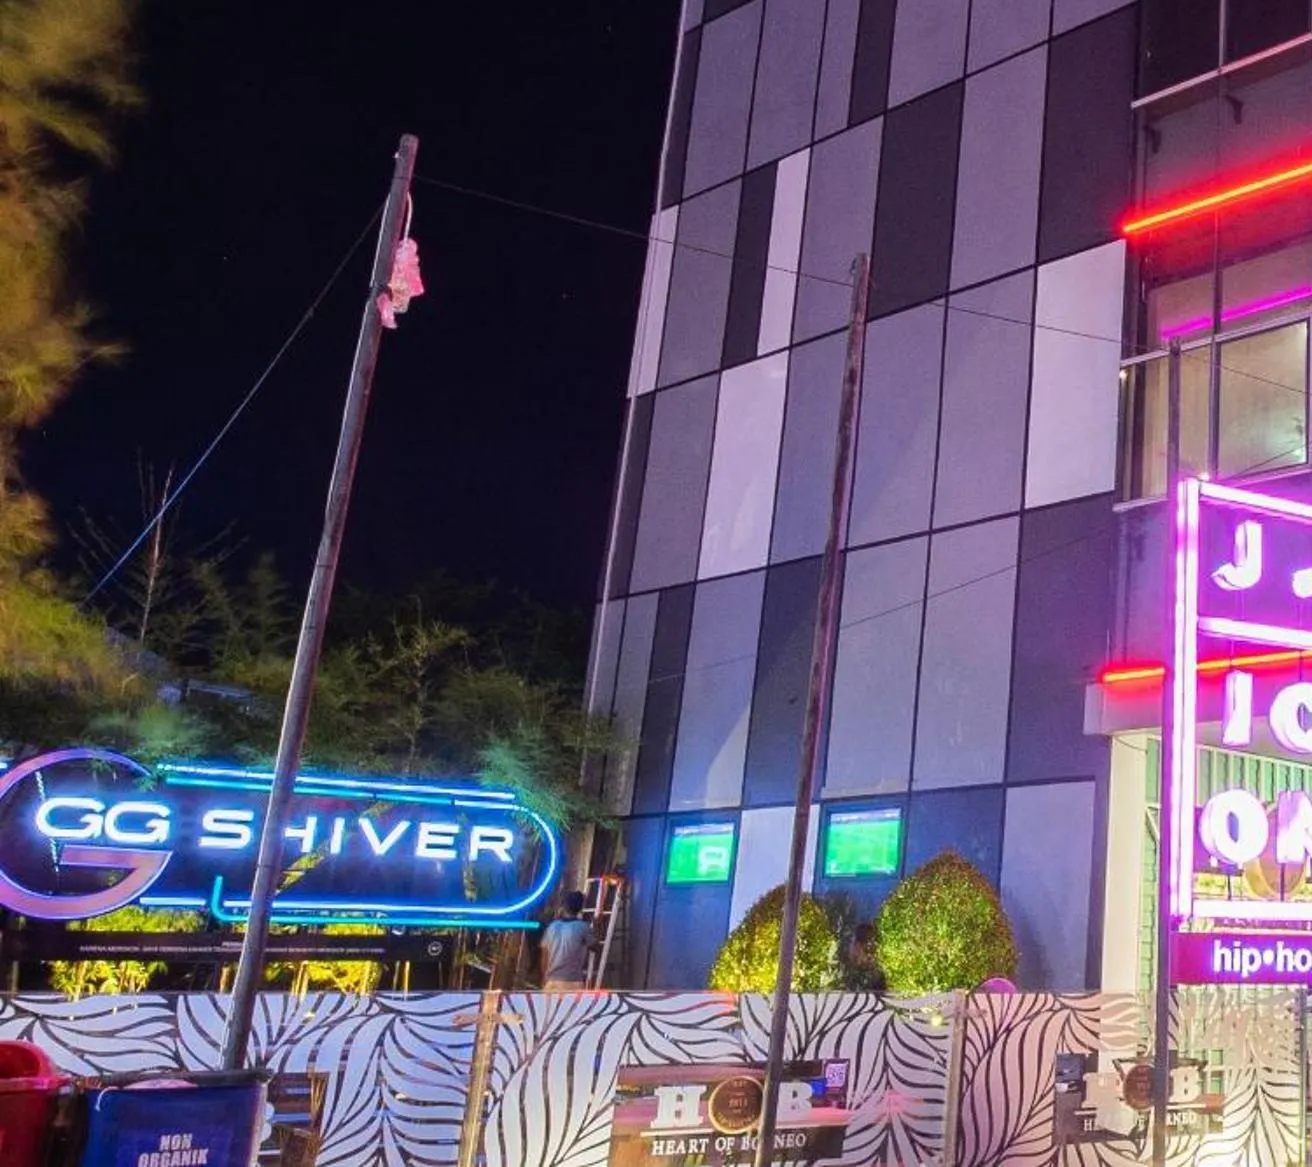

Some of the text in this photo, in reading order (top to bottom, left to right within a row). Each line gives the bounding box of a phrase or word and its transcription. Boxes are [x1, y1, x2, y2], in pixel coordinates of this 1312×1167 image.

[35, 796, 171, 844] GG
[159, 1133, 193, 1152] NON
[651, 1132, 808, 1156] HEART OF BONEO
